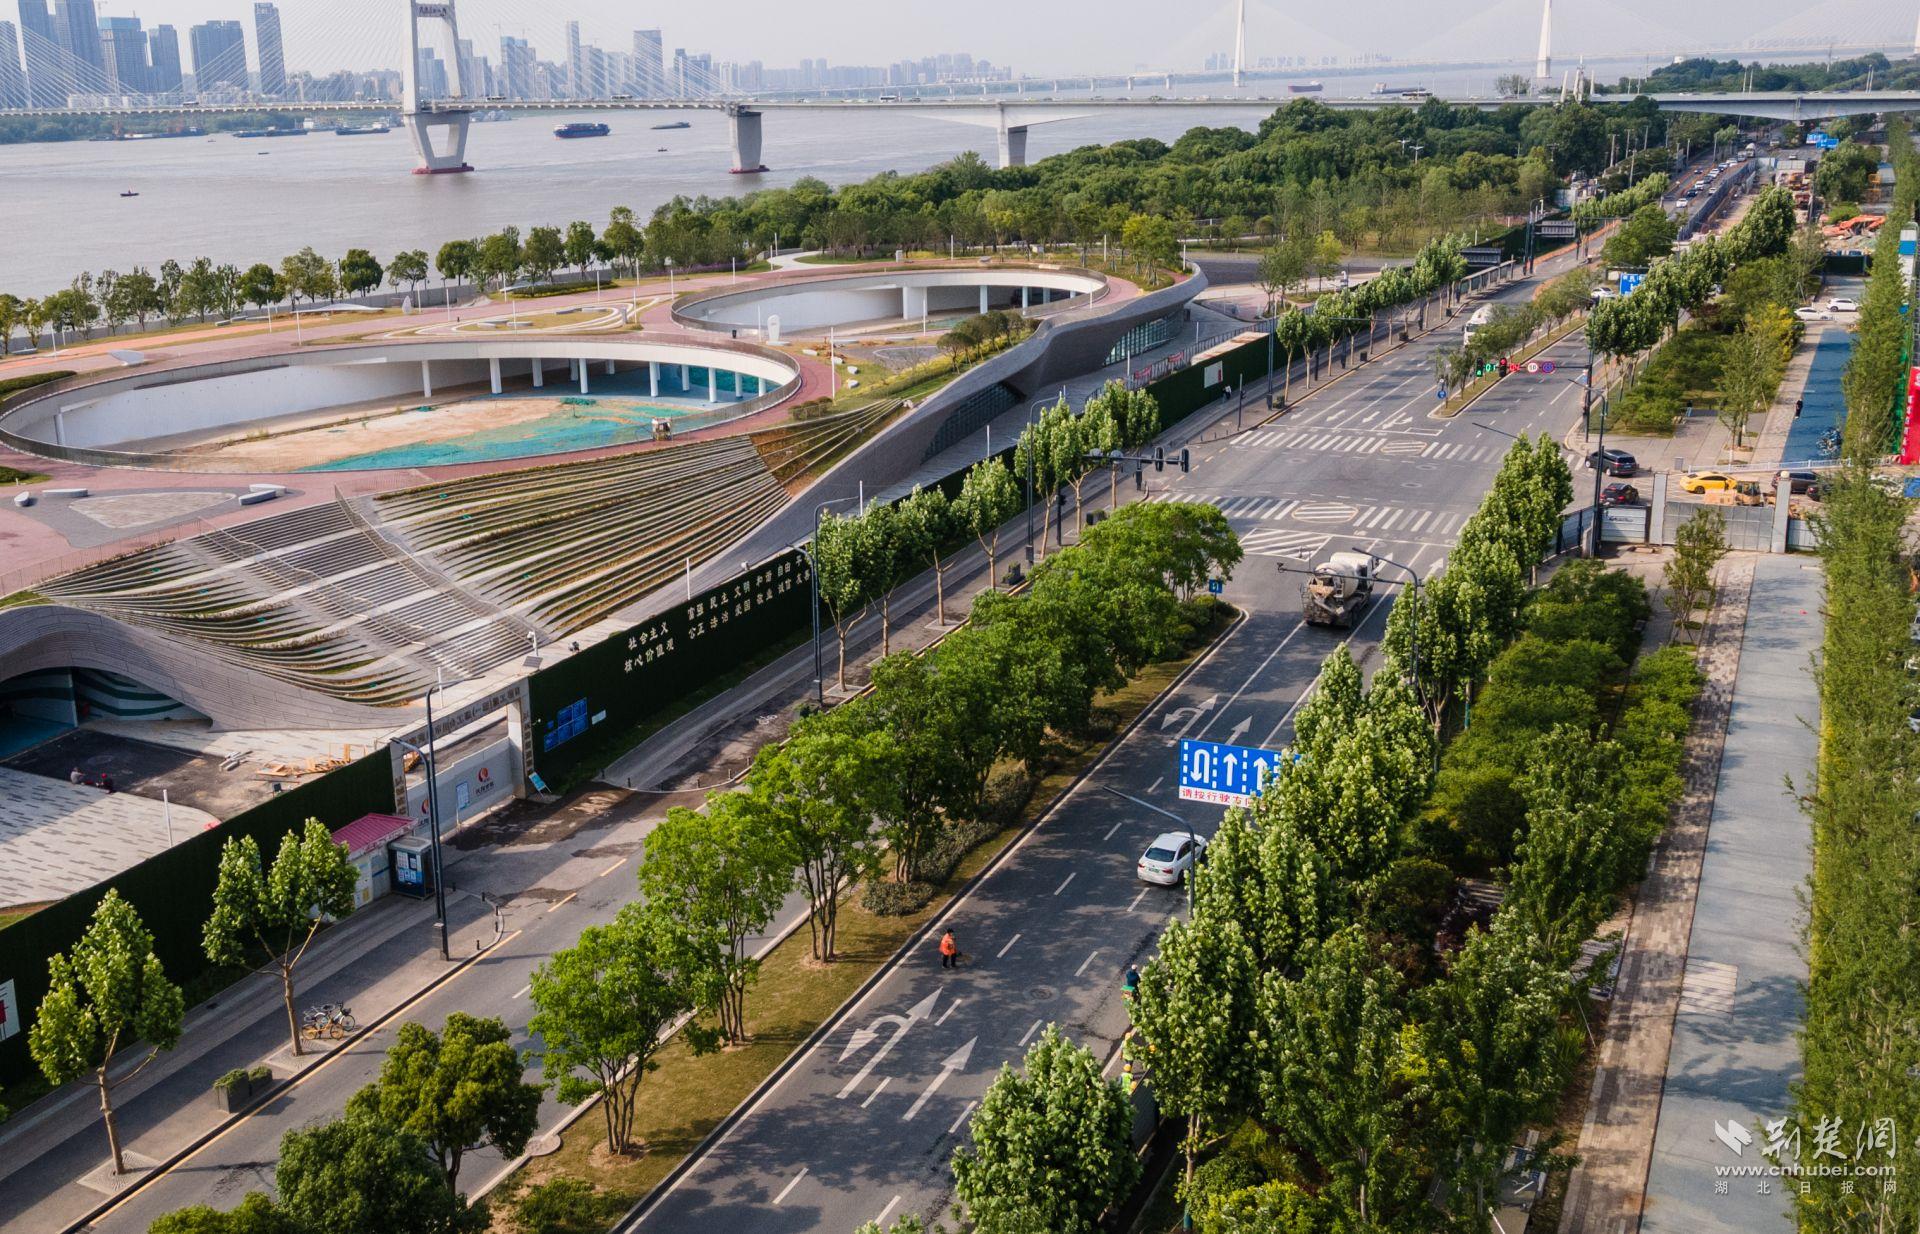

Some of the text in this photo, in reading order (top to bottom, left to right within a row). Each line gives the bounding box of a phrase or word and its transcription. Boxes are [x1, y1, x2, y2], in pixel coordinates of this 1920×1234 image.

[710, 592, 728, 609] 民主
[734, 582, 750, 598] 文明
[778, 562, 791, 577] 自由
[628, 621, 669, 651] 社会主义
[624, 638, 674, 673] 核心价值观
